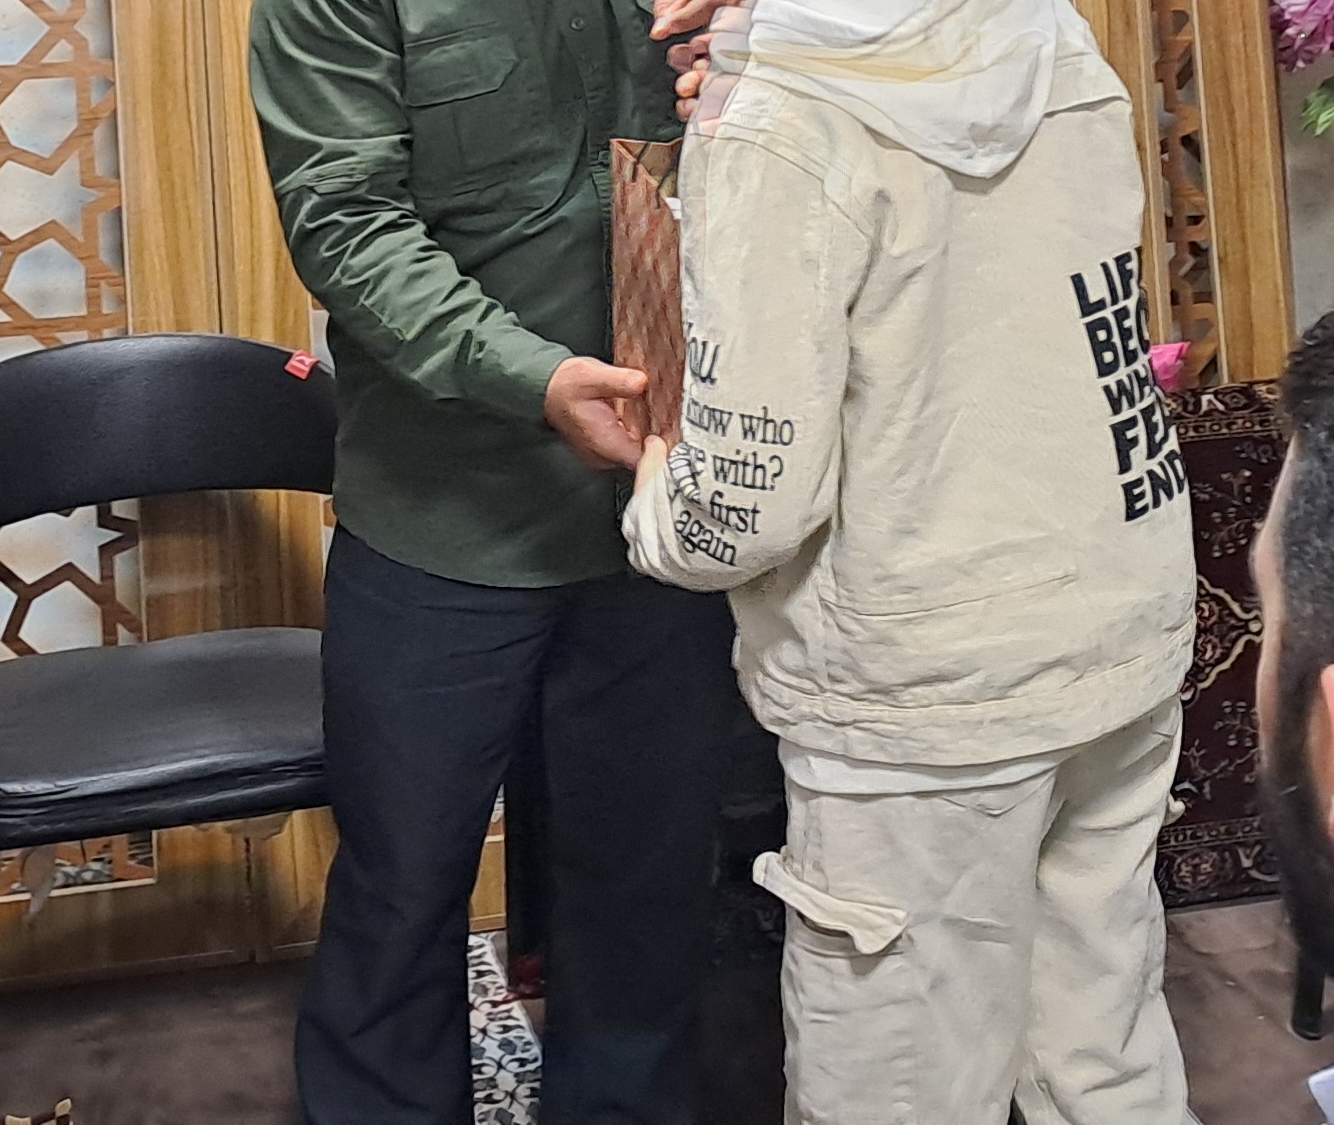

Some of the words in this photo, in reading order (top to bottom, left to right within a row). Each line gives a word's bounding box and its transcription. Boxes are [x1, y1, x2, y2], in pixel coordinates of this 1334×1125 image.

[685, 322, 720, 386] ou
[1102, 360, 1158, 416] WH
[739, 405, 795, 446] who
[712, 448, 785, 492] with?
[709, 489, 762, 535] first
[675, 509, 737, 567] again
